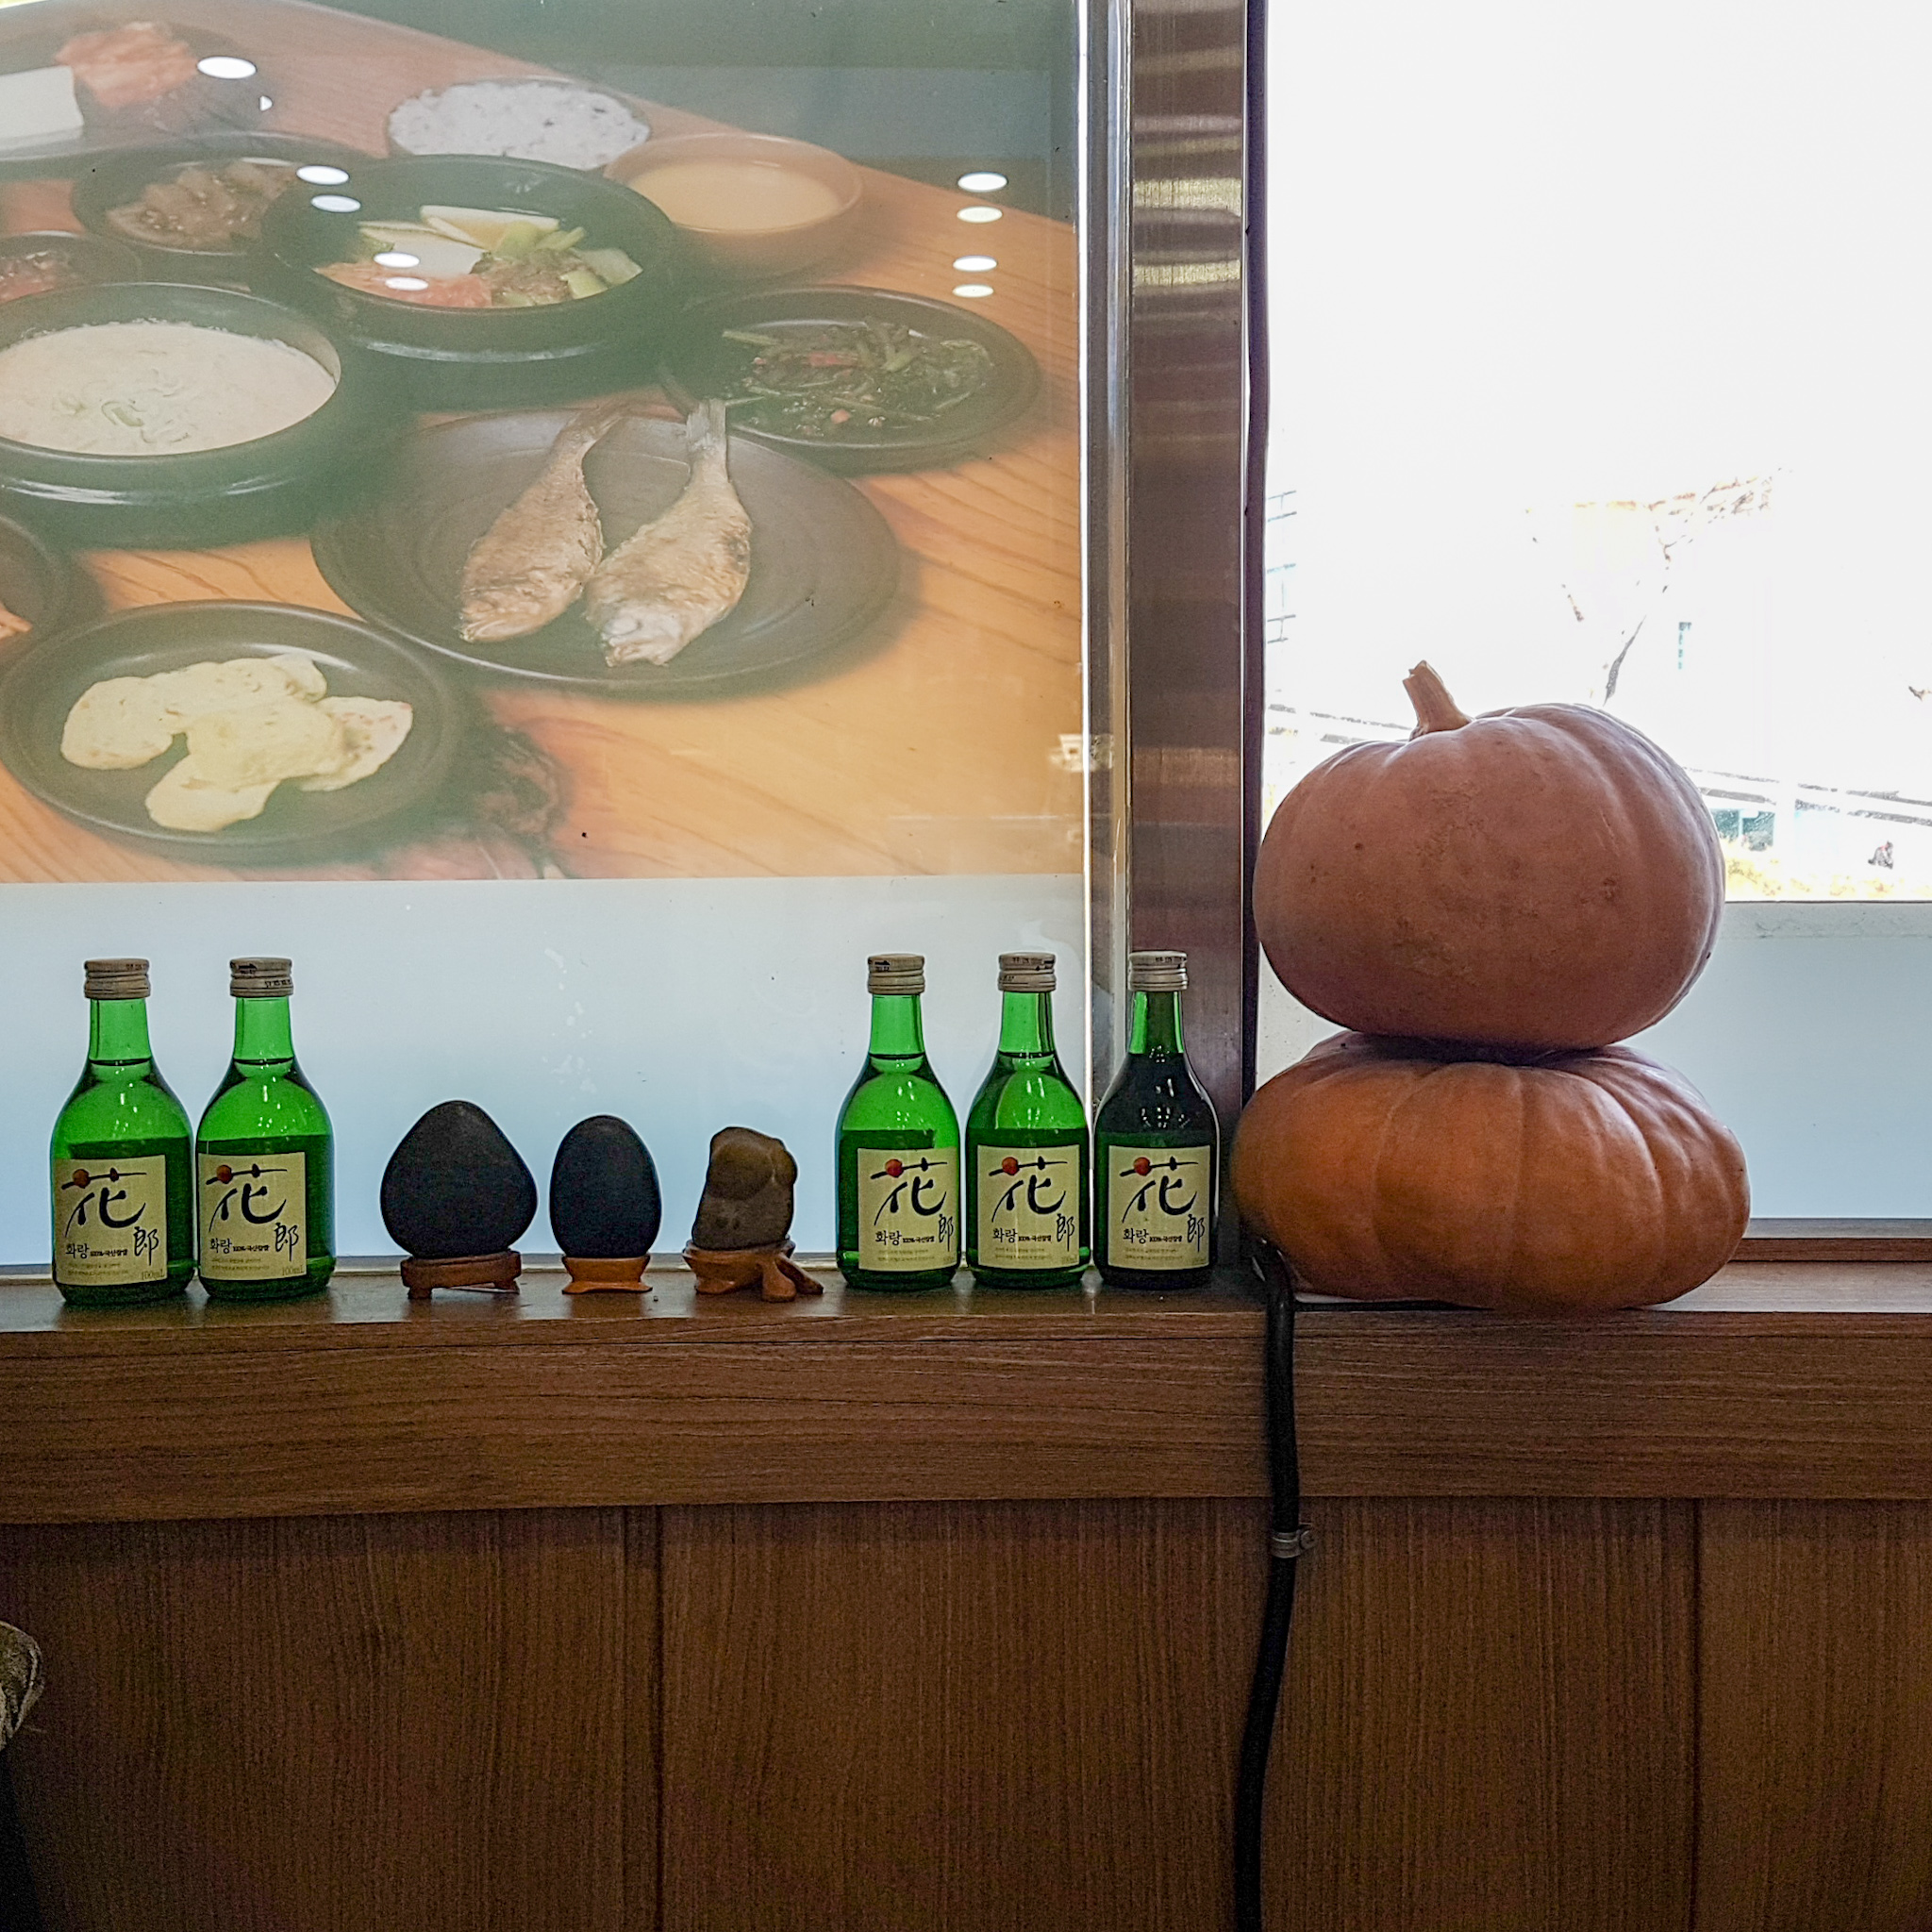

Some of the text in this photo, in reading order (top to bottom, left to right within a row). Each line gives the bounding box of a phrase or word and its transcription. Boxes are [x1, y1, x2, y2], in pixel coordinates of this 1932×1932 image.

[874, 1229, 903, 1246] 화랑
[992, 1227, 1018, 1243] 화랑
[1123, 1227, 1150, 1244] 화랑
[65, 1242, 90, 1259] 화랑
[209, 1238, 233, 1255] 화랑
